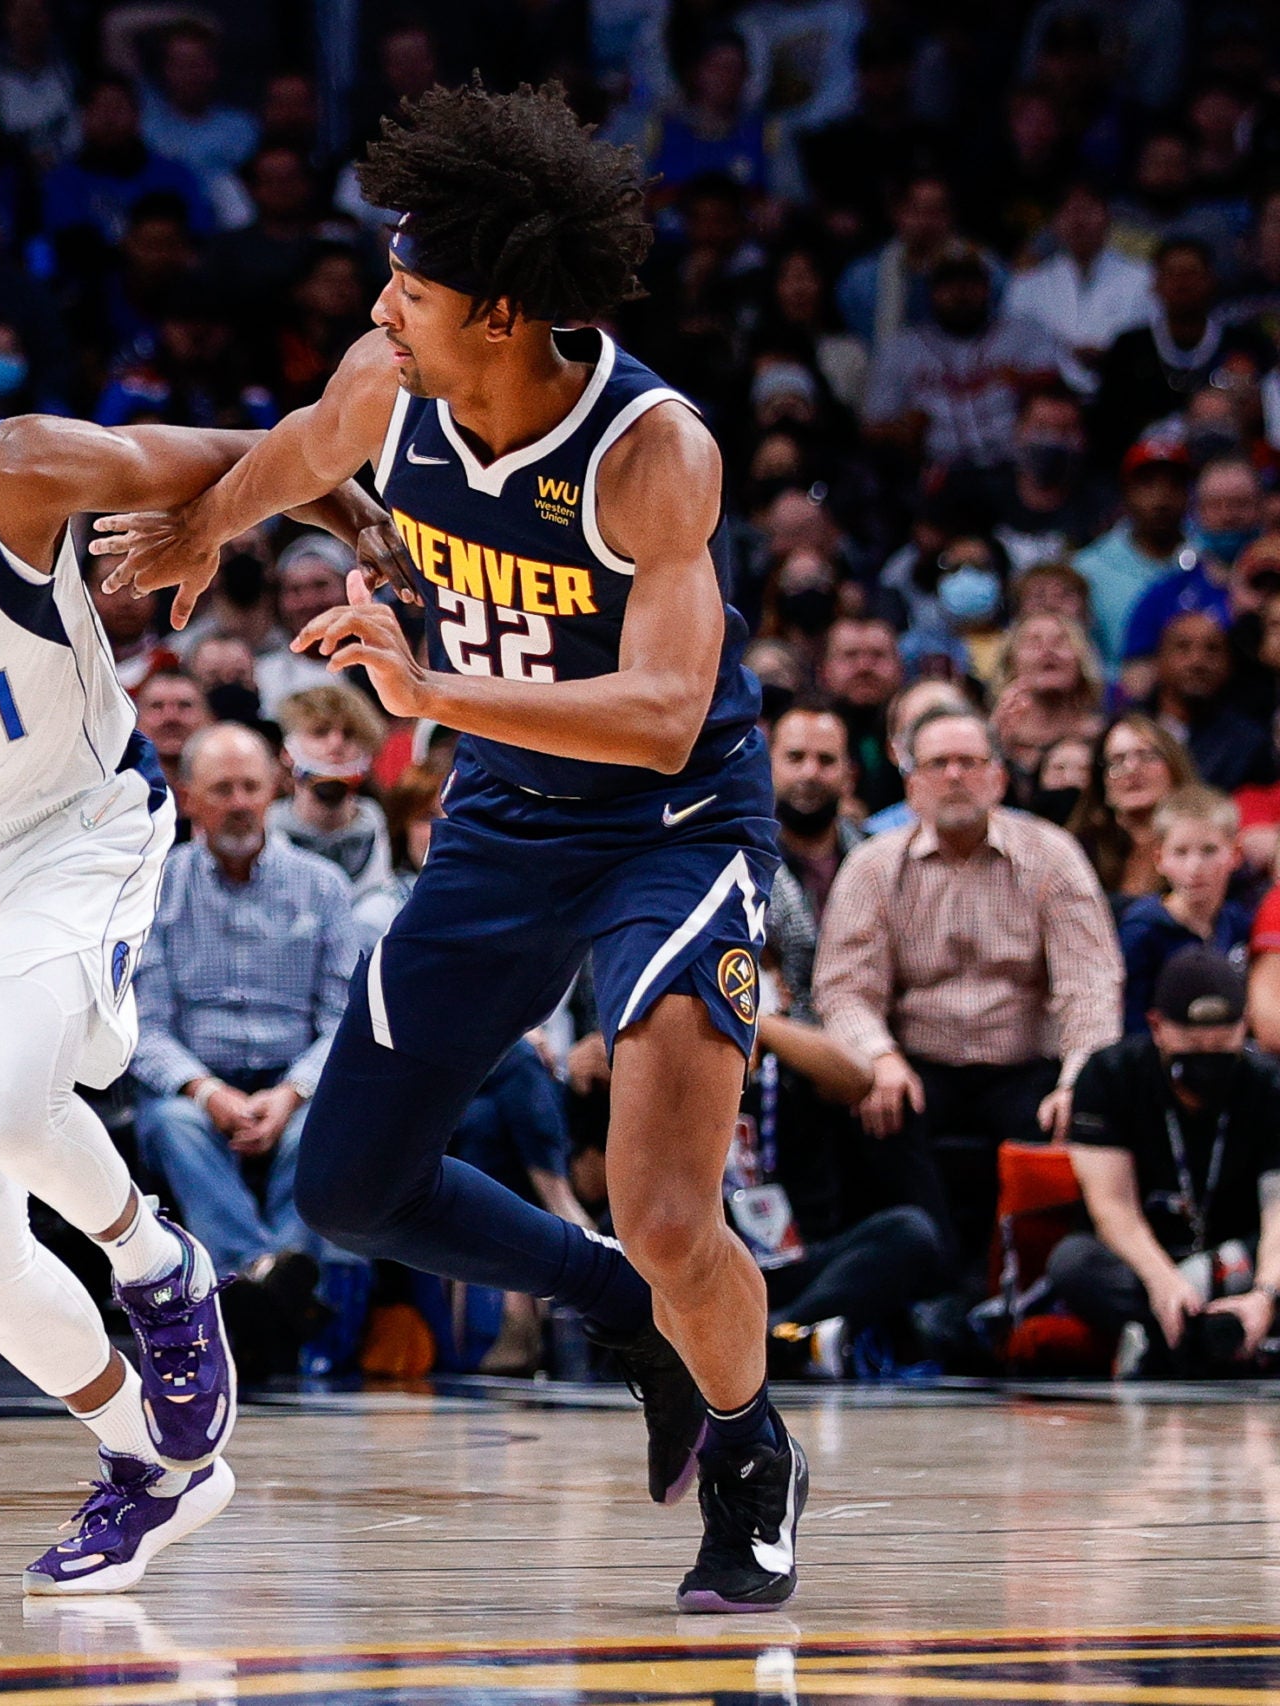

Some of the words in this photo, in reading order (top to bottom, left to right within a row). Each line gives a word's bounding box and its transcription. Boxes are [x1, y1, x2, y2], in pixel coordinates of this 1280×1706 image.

[538, 476, 581, 506] WU
[534, 498, 576, 519] Western
[540, 510, 569, 527] Union
[437, 586, 556, 684] 22
